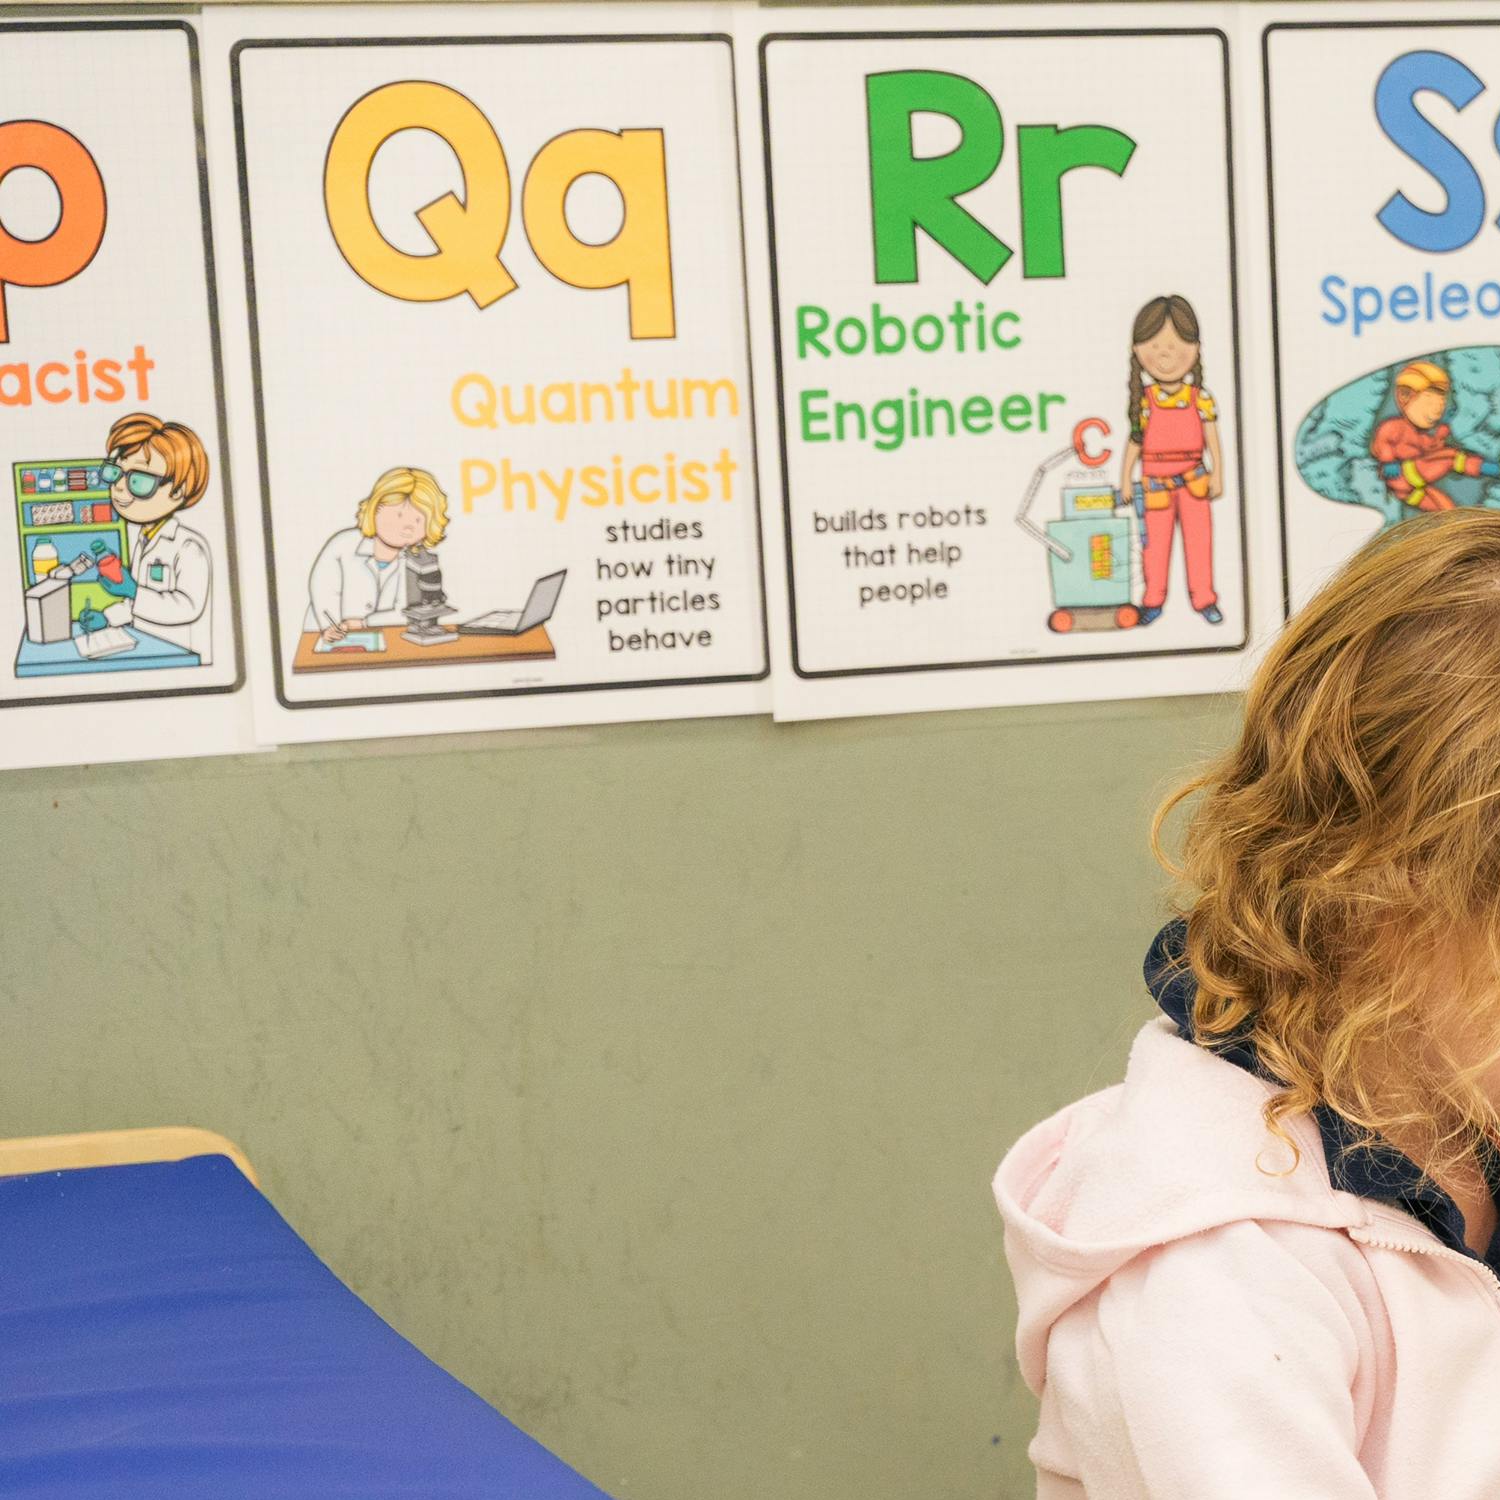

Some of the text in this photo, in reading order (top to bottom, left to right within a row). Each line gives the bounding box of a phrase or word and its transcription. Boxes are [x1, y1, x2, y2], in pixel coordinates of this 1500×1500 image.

[865, 69, 1138, 286] Rr
[324, 80, 677, 341] Qq
[798, 302, 1022, 358] Robotic
[0, 345, 156, 408] acist
[451, 369, 740, 428] Quantum
[799, 389, 1066, 450] Engineer
[460, 449, 739, 521] Physicist
[605, 518, 705, 543] studies
[813, 504, 988, 534] builds robots
[596, 553, 716, 582] how tiny
[843, 537, 962, 567] that help
[597, 588, 721, 618] particles
[859, 577, 949, 607] people
[609, 624, 714, 651] behave
